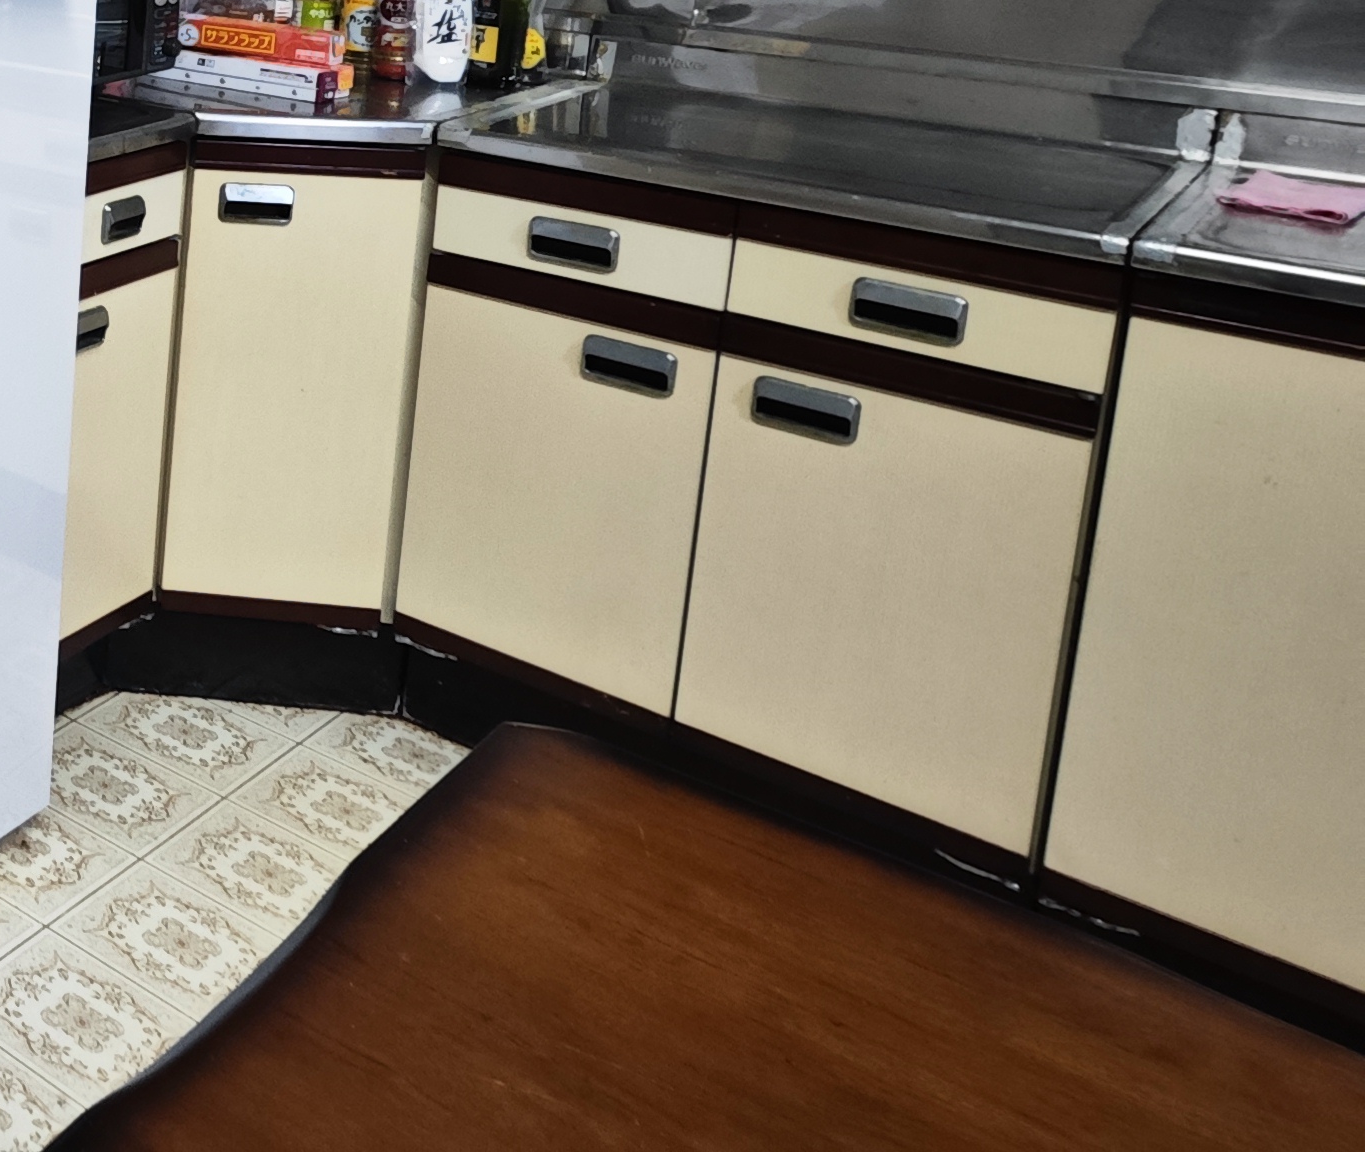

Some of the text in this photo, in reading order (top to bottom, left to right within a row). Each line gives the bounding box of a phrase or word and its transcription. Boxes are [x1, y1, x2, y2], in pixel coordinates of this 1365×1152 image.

[206, 29, 271, 49] サランラップ
